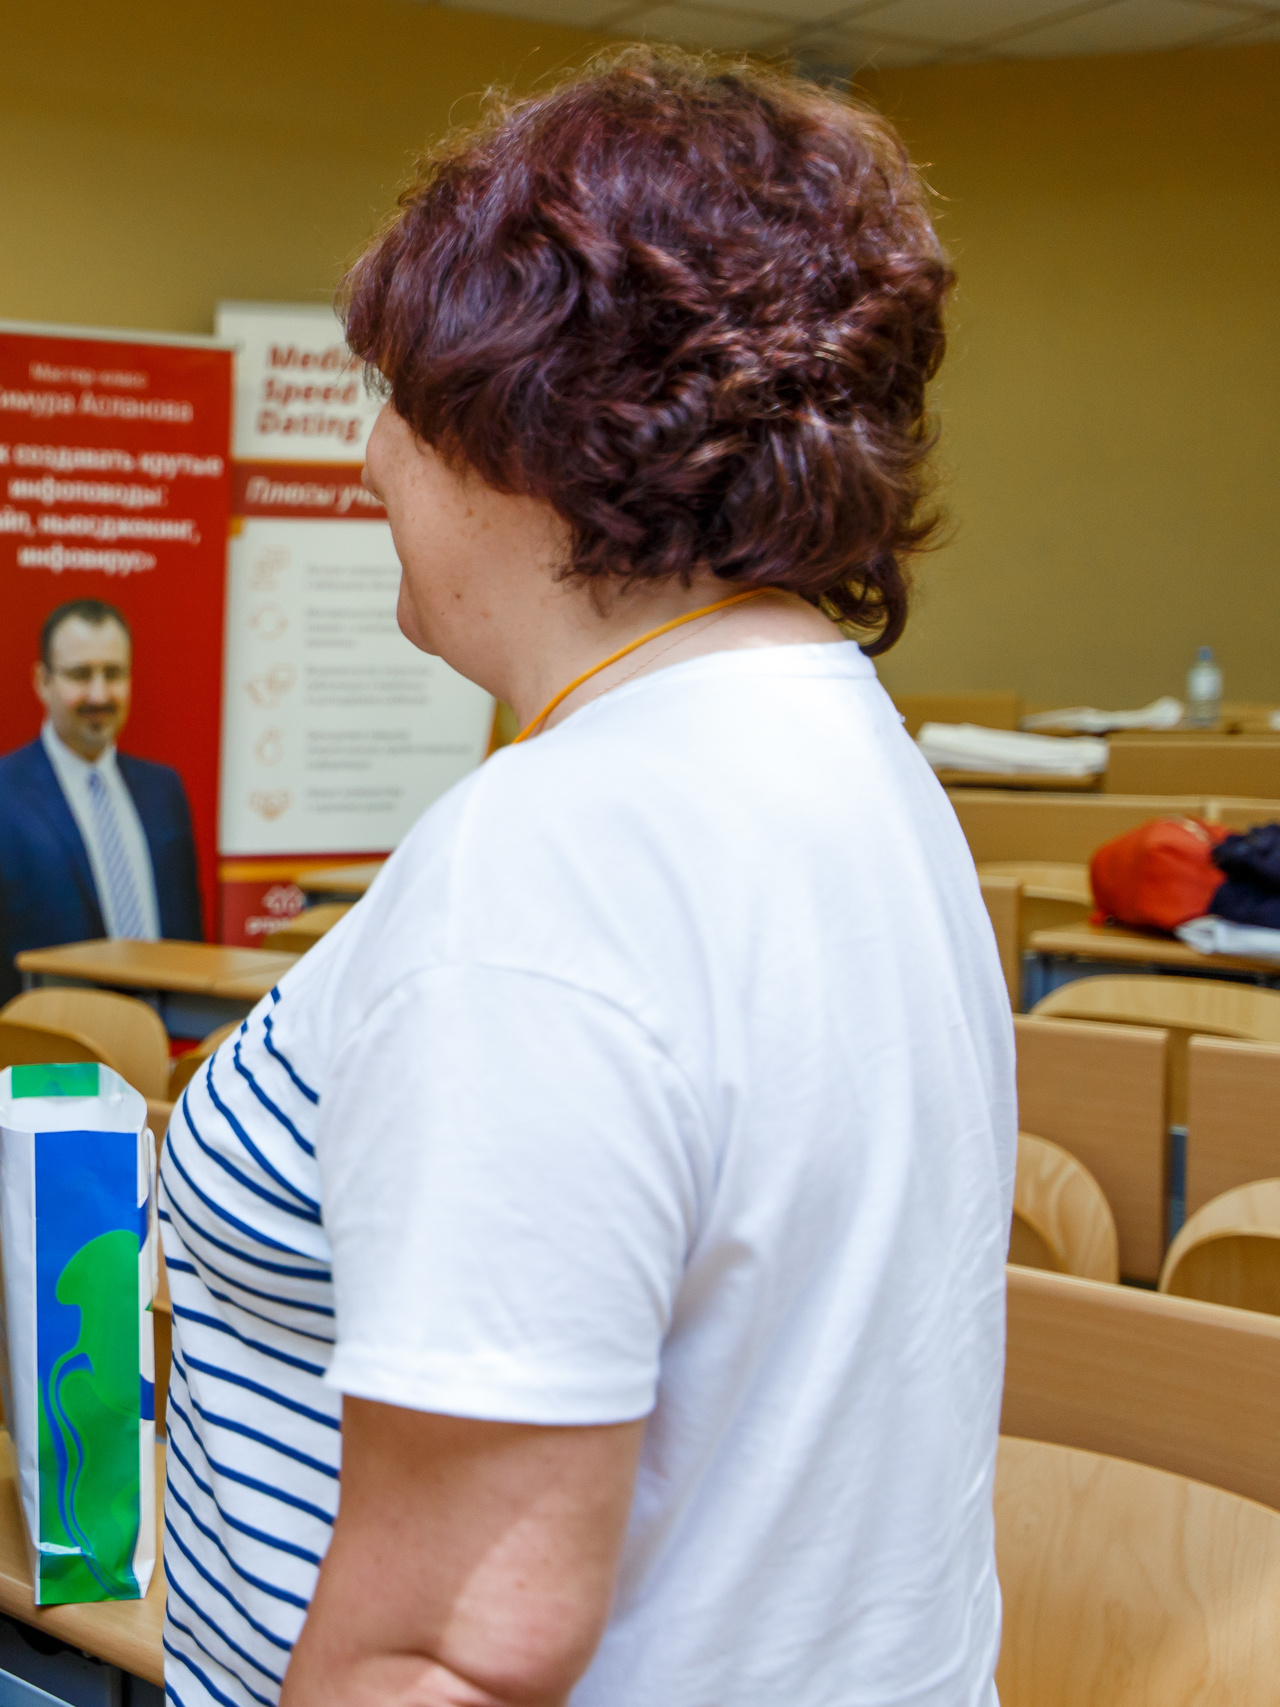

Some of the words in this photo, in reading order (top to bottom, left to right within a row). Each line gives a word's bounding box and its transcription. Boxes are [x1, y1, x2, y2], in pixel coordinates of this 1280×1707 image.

[265, 378, 358, 405] Speed
[258, 411, 361, 443] Dating
[12, 443, 136, 472] создавать
[138, 452, 223, 480] крутые
[245, 475, 335, 507] Плюсы
[17, 541, 156, 577] инфовирус»
